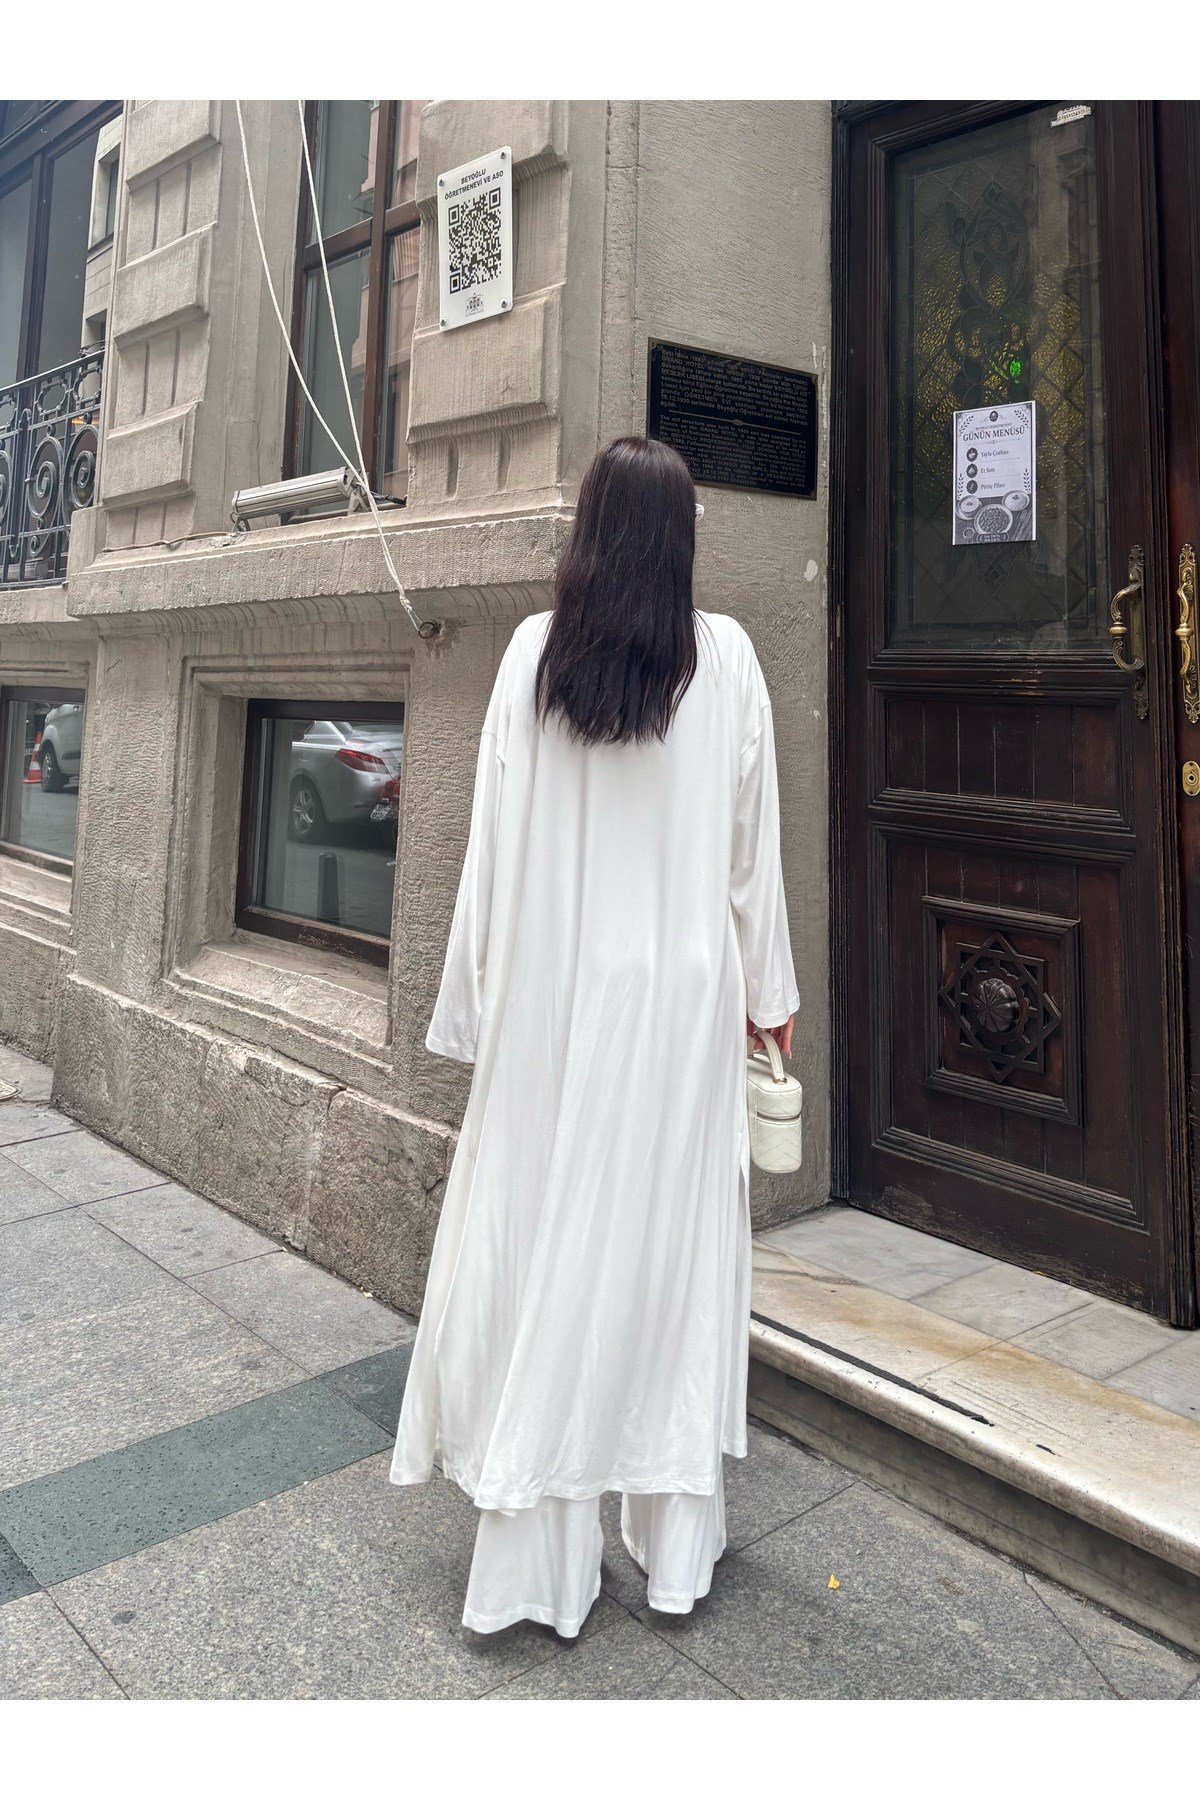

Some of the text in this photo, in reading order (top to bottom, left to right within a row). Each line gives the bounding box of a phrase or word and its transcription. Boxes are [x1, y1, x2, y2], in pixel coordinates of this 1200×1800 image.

[445, 170, 504, 200] ÖĞRETMENEVİ VE ASO
[461, 169, 486, 185] BEYOĞLU
[963, 425, 1025, 441] GÜNÜN MENÜSÜ
